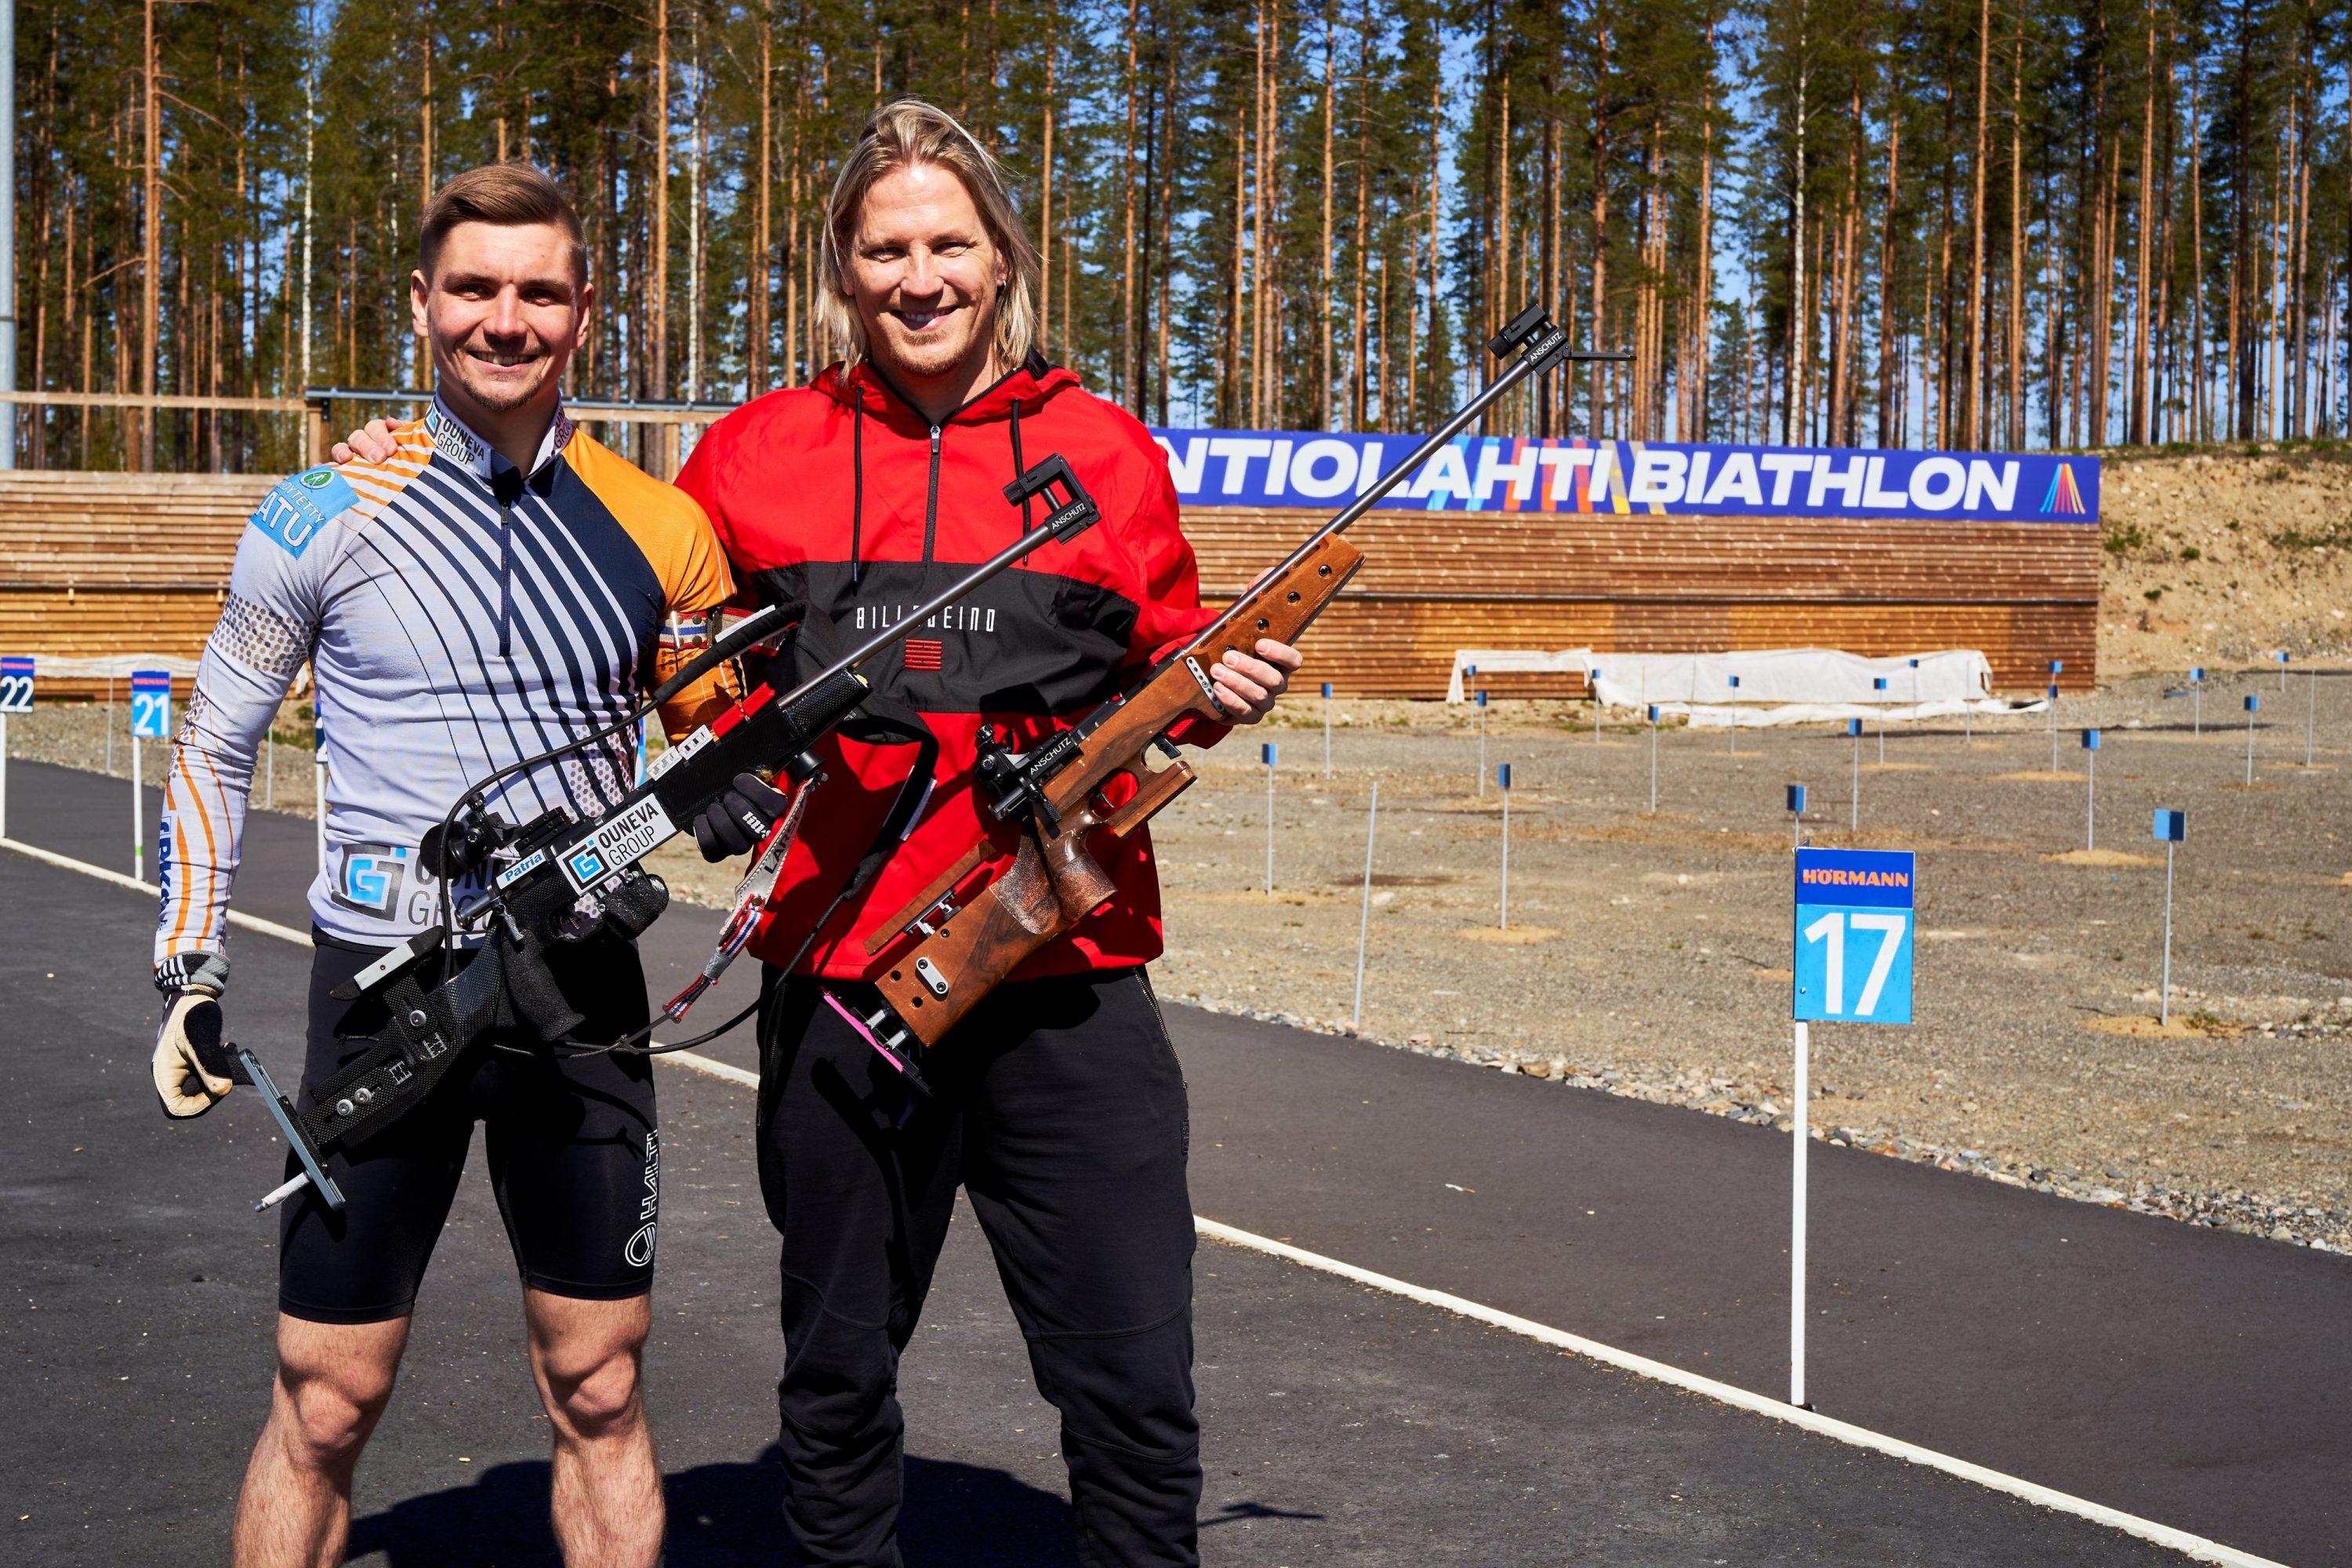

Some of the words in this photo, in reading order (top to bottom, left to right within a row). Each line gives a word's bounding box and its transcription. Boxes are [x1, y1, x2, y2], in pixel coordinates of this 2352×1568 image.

[437, 433, 474, 465] GROUP
[443, 418, 485, 460] OUNEVA
[1628, 450, 2020, 511] BIATHLON
[0, 676, 34, 713] 22
[134, 694, 169, 735] 21
[598, 802, 659, 849] OUNEVA
[608, 826, 655, 866] GROUP
[505, 853, 543, 882] Patria
[1802, 869, 1908, 887] HÖRMANN
[1804, 912, 1906, 1016] 17
[641, 1128, 659, 1221] HALTI
